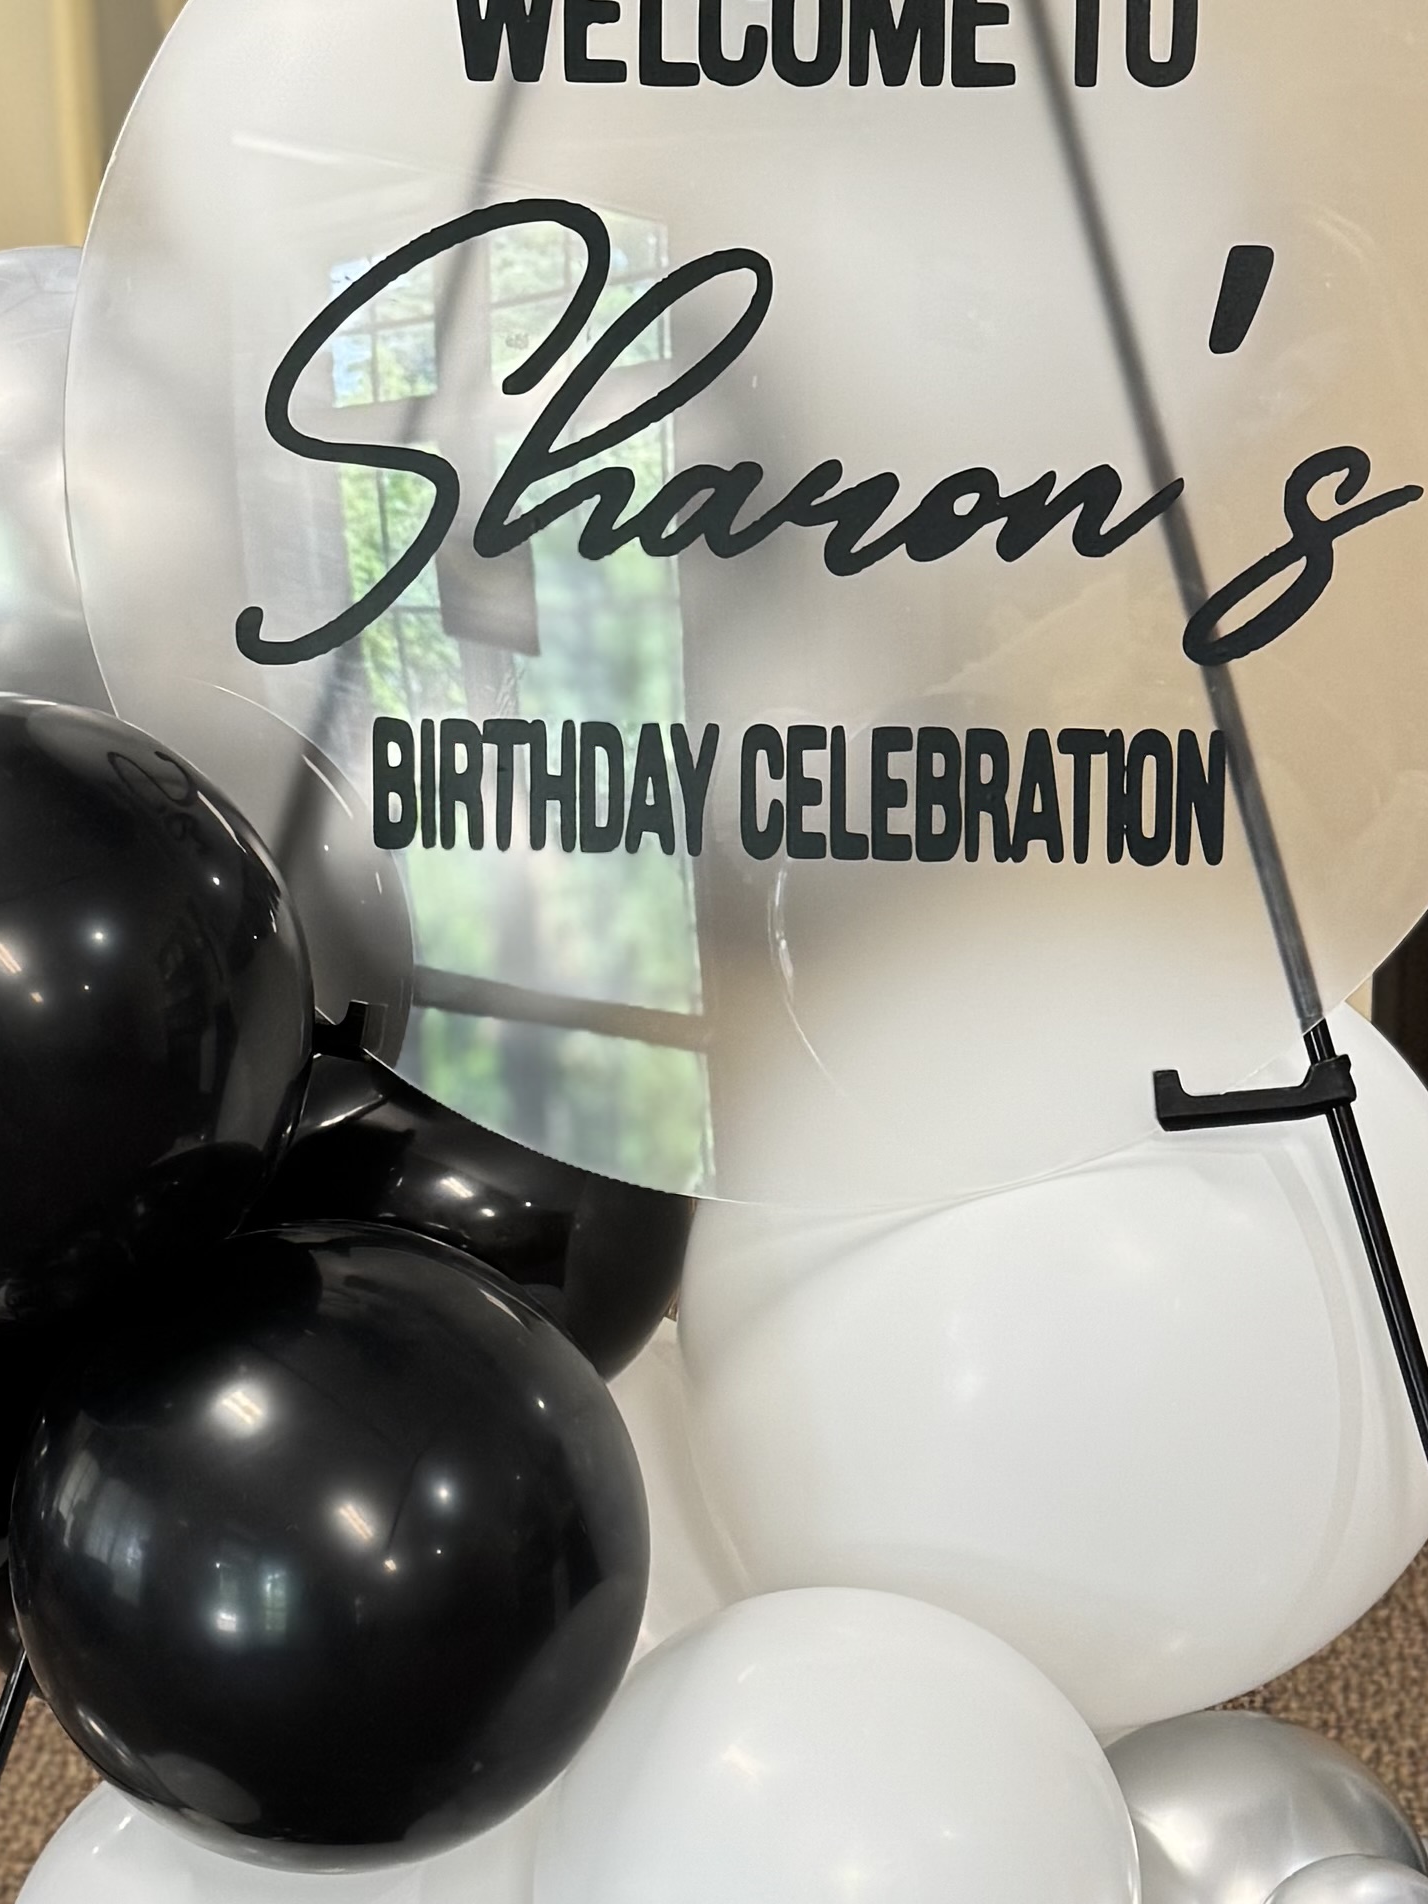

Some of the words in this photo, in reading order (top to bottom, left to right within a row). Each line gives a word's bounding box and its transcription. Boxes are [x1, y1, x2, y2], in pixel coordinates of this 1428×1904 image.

[235, 198, 1424, 667] Sharon's
[372, 716, 721, 857] BIRTHDAY
[740, 723, 1228, 867] CELEBRATION
